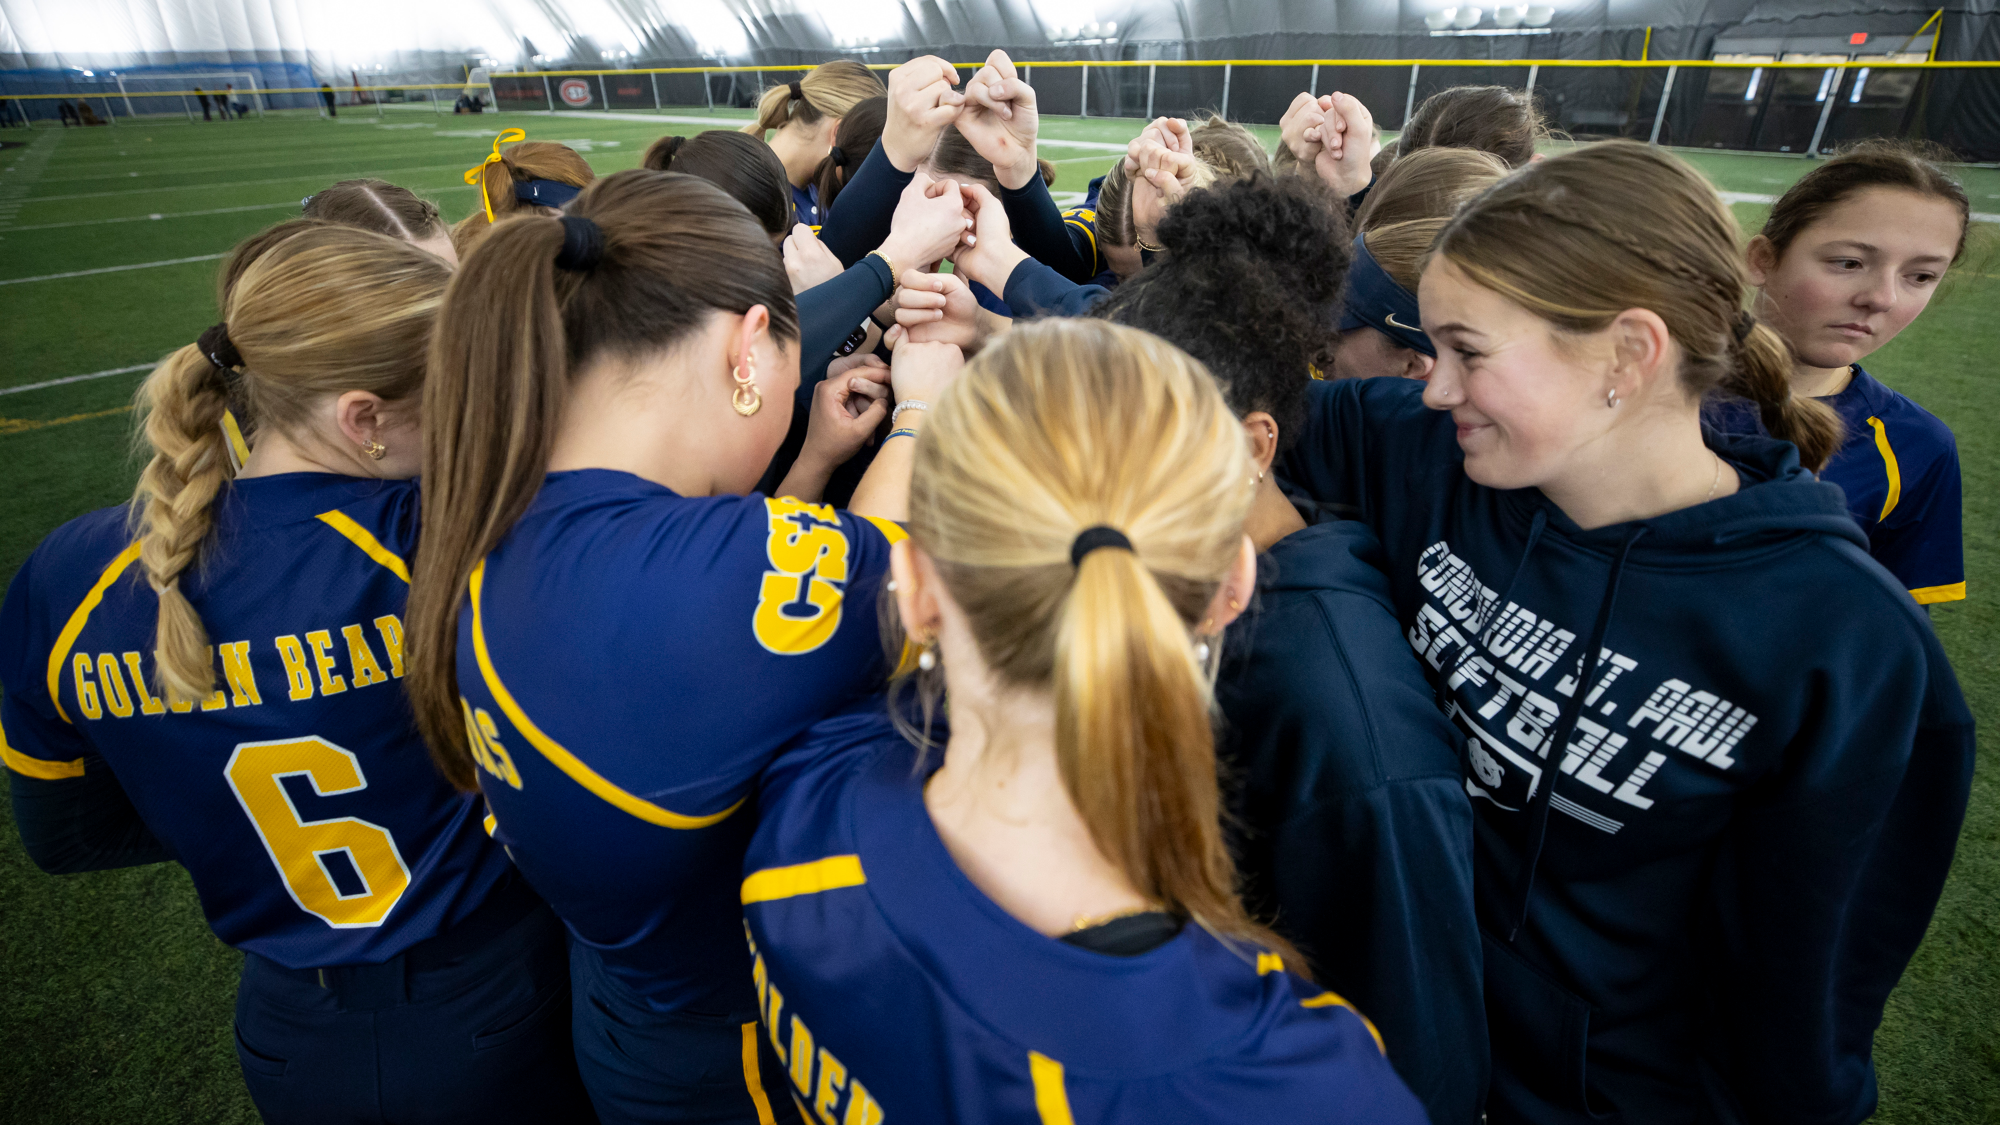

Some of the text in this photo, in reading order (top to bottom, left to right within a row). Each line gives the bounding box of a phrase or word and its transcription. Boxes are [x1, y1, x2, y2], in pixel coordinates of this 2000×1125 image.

[72, 640, 263, 720] GOLN
[1408, 602, 1668, 811] SOFTBALL
[1417, 541, 1759, 770] CONCORDIA ST. PAUL
[223, 735, 412, 929] 6
